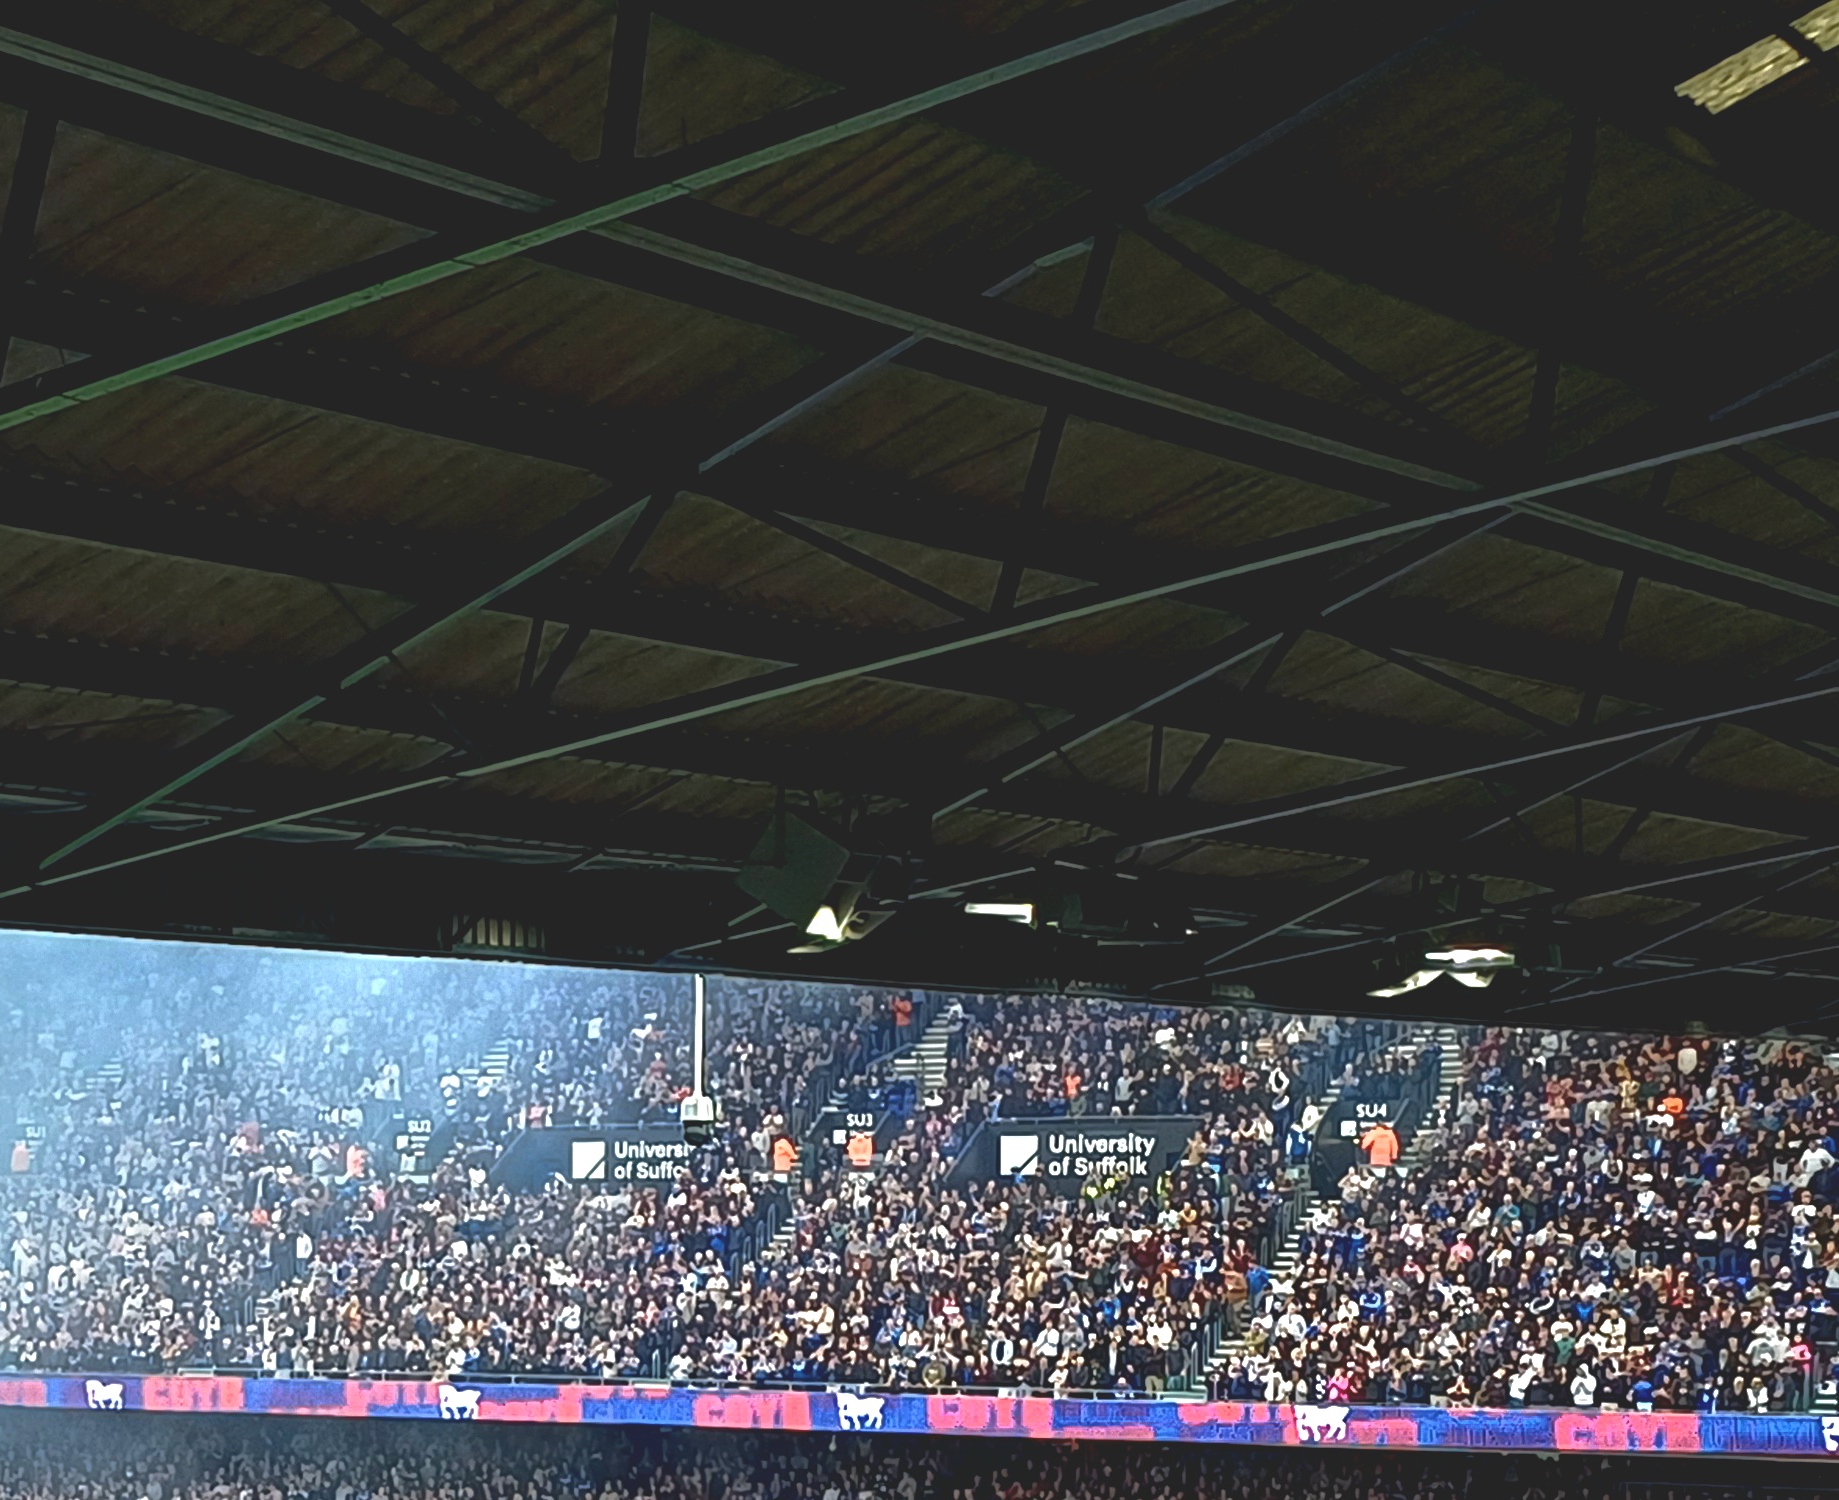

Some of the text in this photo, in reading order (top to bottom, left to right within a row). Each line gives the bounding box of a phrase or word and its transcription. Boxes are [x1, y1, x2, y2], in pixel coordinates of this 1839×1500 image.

[1355, 1102, 1387, 1119] SU4
[614, 1140, 696, 1159] Universi
[1048, 1132, 1156, 1157] University
[614, 1161, 690, 1179] of Suffo
[1048, 1156, 1148, 1177] of Suffolk
